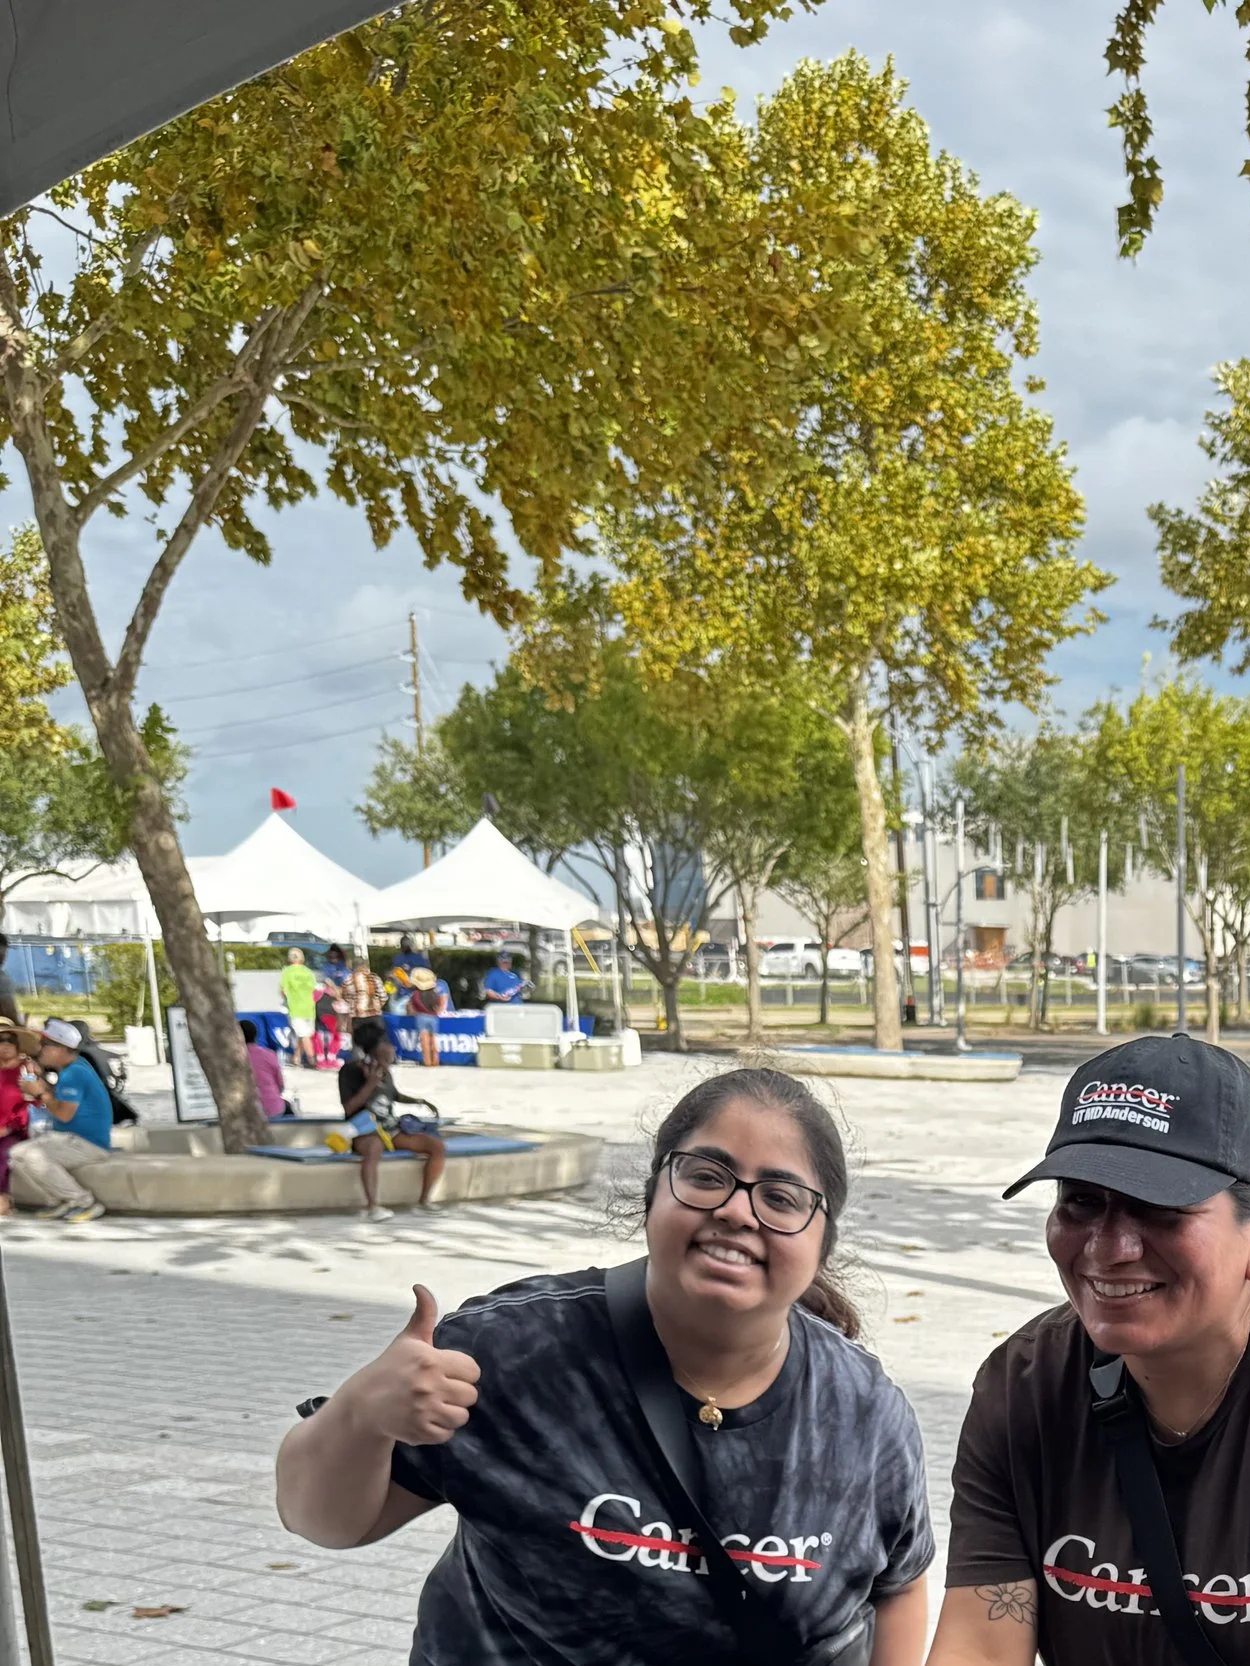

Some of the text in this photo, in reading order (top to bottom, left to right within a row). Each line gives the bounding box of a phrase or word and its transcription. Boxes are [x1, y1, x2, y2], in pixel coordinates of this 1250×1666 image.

[1072, 1106, 1170, 1133] UT MD Anderson
